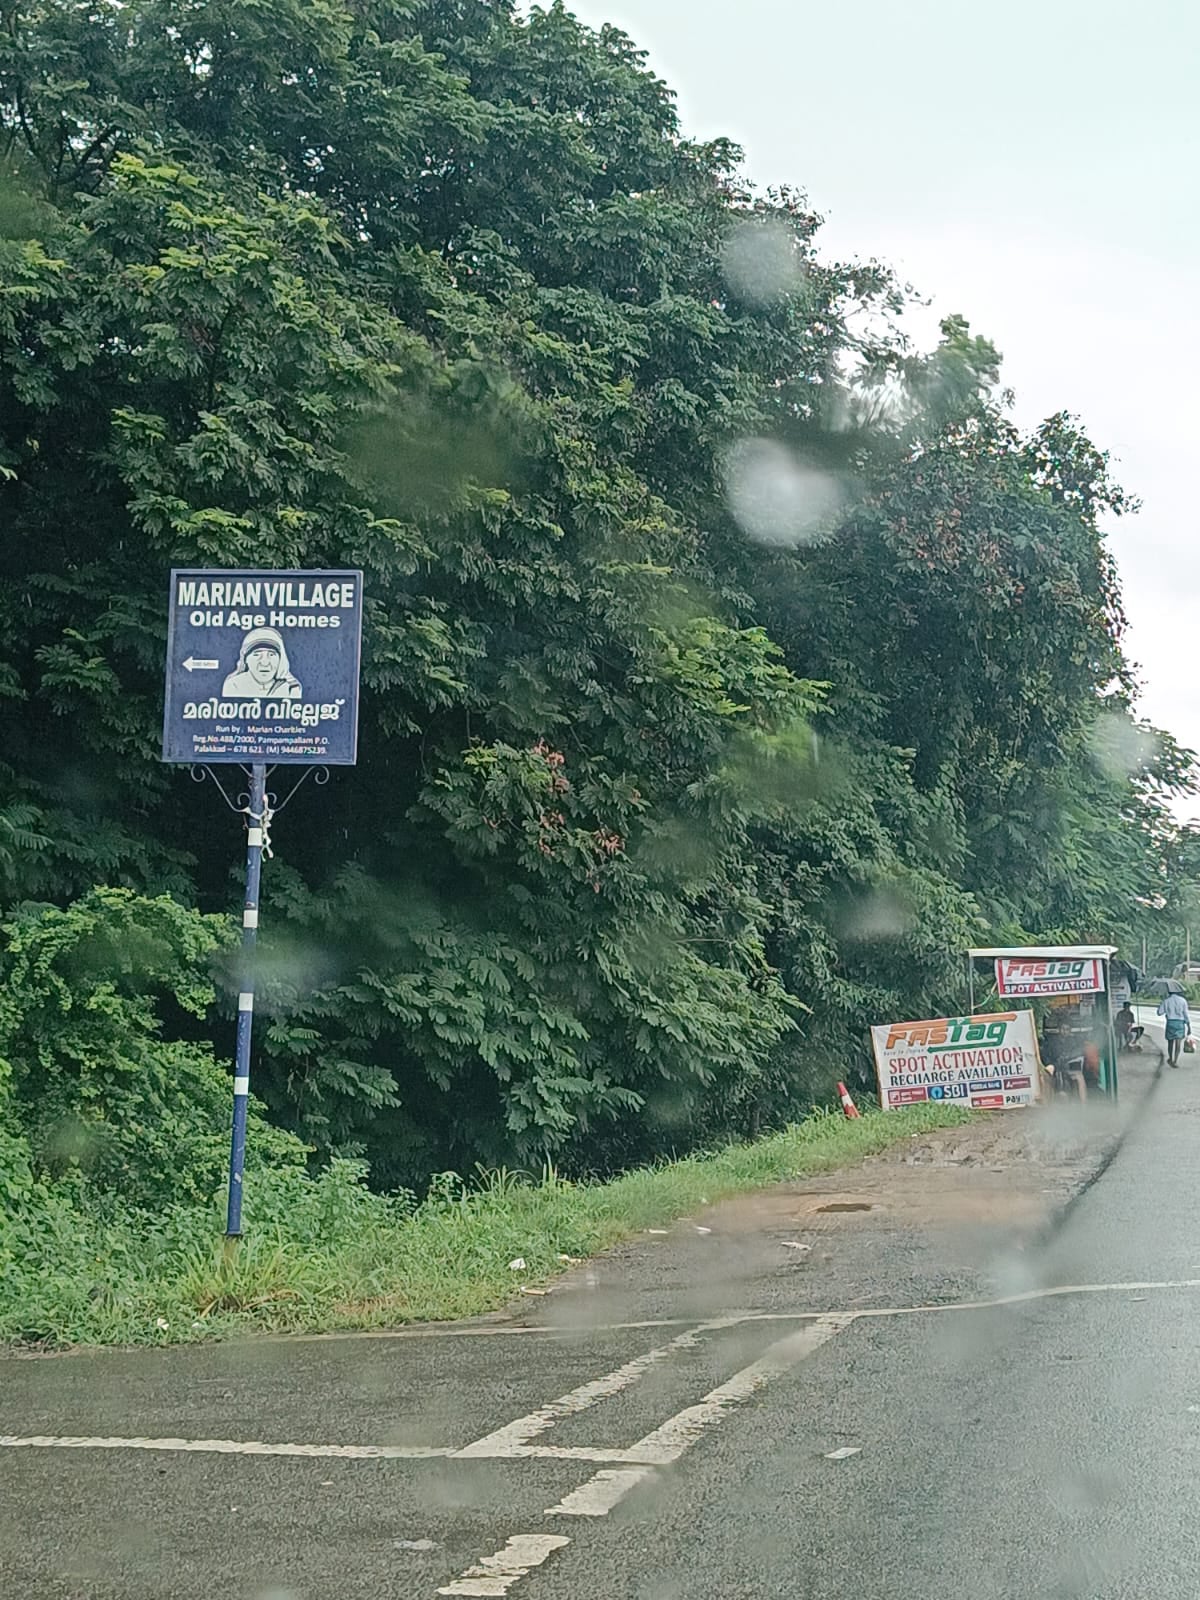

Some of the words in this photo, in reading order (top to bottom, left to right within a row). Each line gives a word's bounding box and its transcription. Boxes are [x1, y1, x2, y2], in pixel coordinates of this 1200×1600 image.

[178, 581, 261, 606] MARIAN
[264, 582, 354, 608] VILLAGE
[190, 611, 223, 627] Old
[226, 611, 265, 630] Age
[269, 611, 341, 628] Homes
[183, 698, 261, 719] മരിയൻ
[215, 725, 232, 733] Run
[247, 725, 273, 734] Marian
[274, 725, 306, 734] Charities
[266, 745, 280, 754] (M)
[1004, 984, 1031, 994] SPOT
[1034, 980, 1095, 993] ACTIVATION
[889, 1056, 928, 1074] SPOT
[932, 1047, 1024, 1070] ACTIVATION
[890, 1071, 956, 1086] RECHARGE
[957, 1064, 1024, 1080] AVAILABLE
[944, 1083, 965, 1098] SBI
